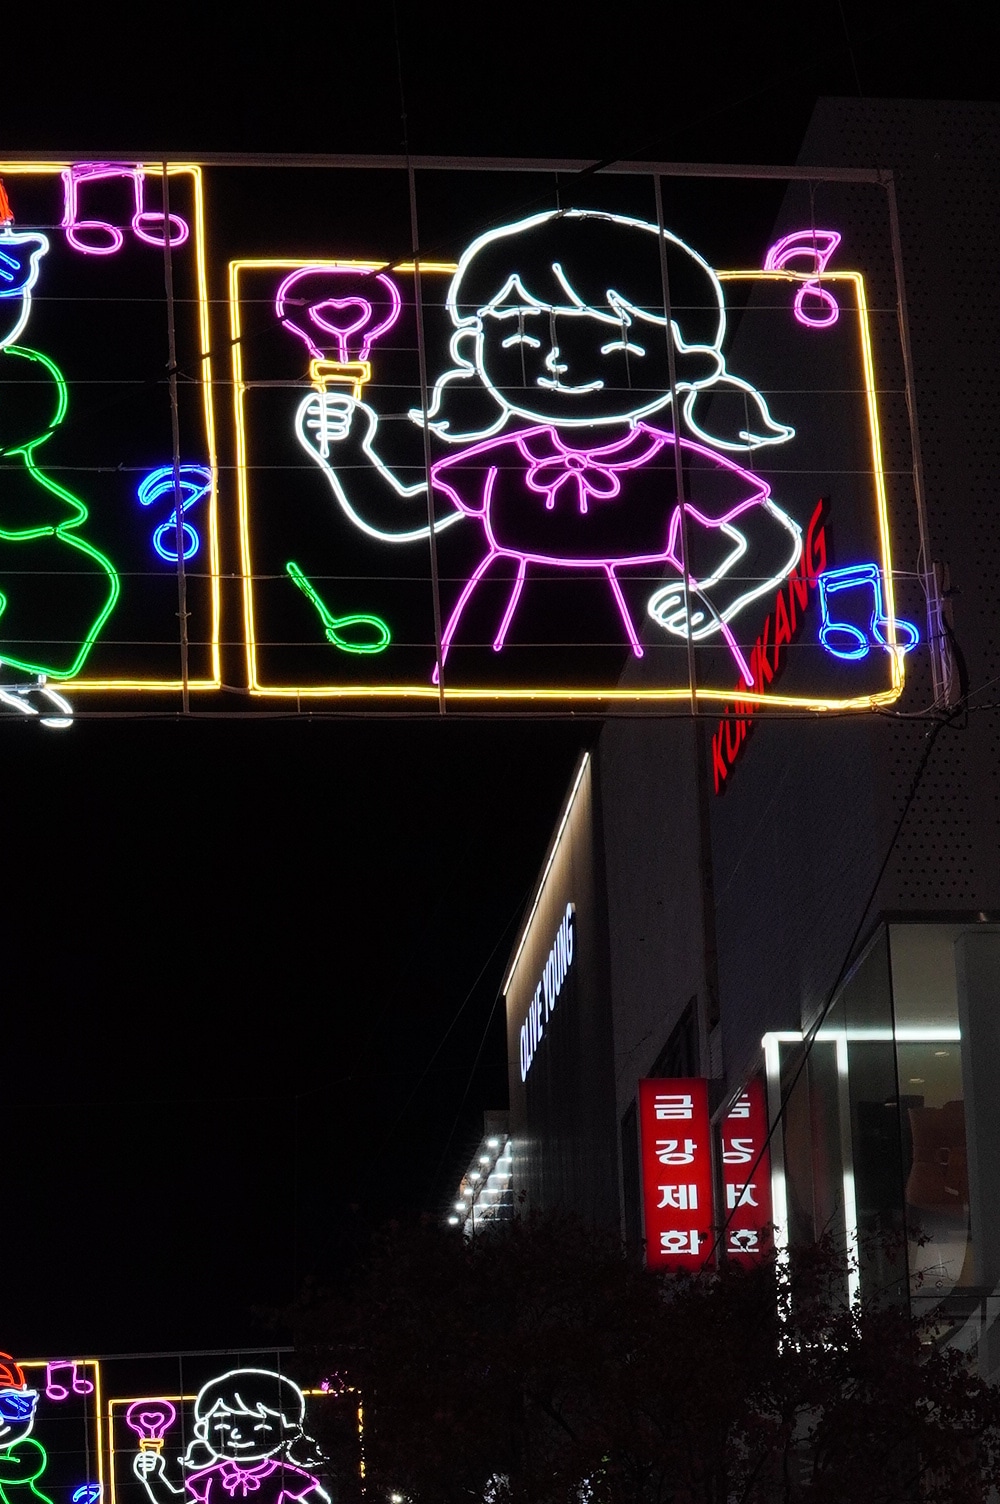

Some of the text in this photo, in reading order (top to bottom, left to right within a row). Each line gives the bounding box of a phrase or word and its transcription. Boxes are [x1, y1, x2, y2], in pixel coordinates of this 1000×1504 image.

[711, 499, 826, 797] KUMKANG
[520, 902, 574, 1082] OLIVE YOUNG
[653, 1095, 703, 1255] 금강제화
